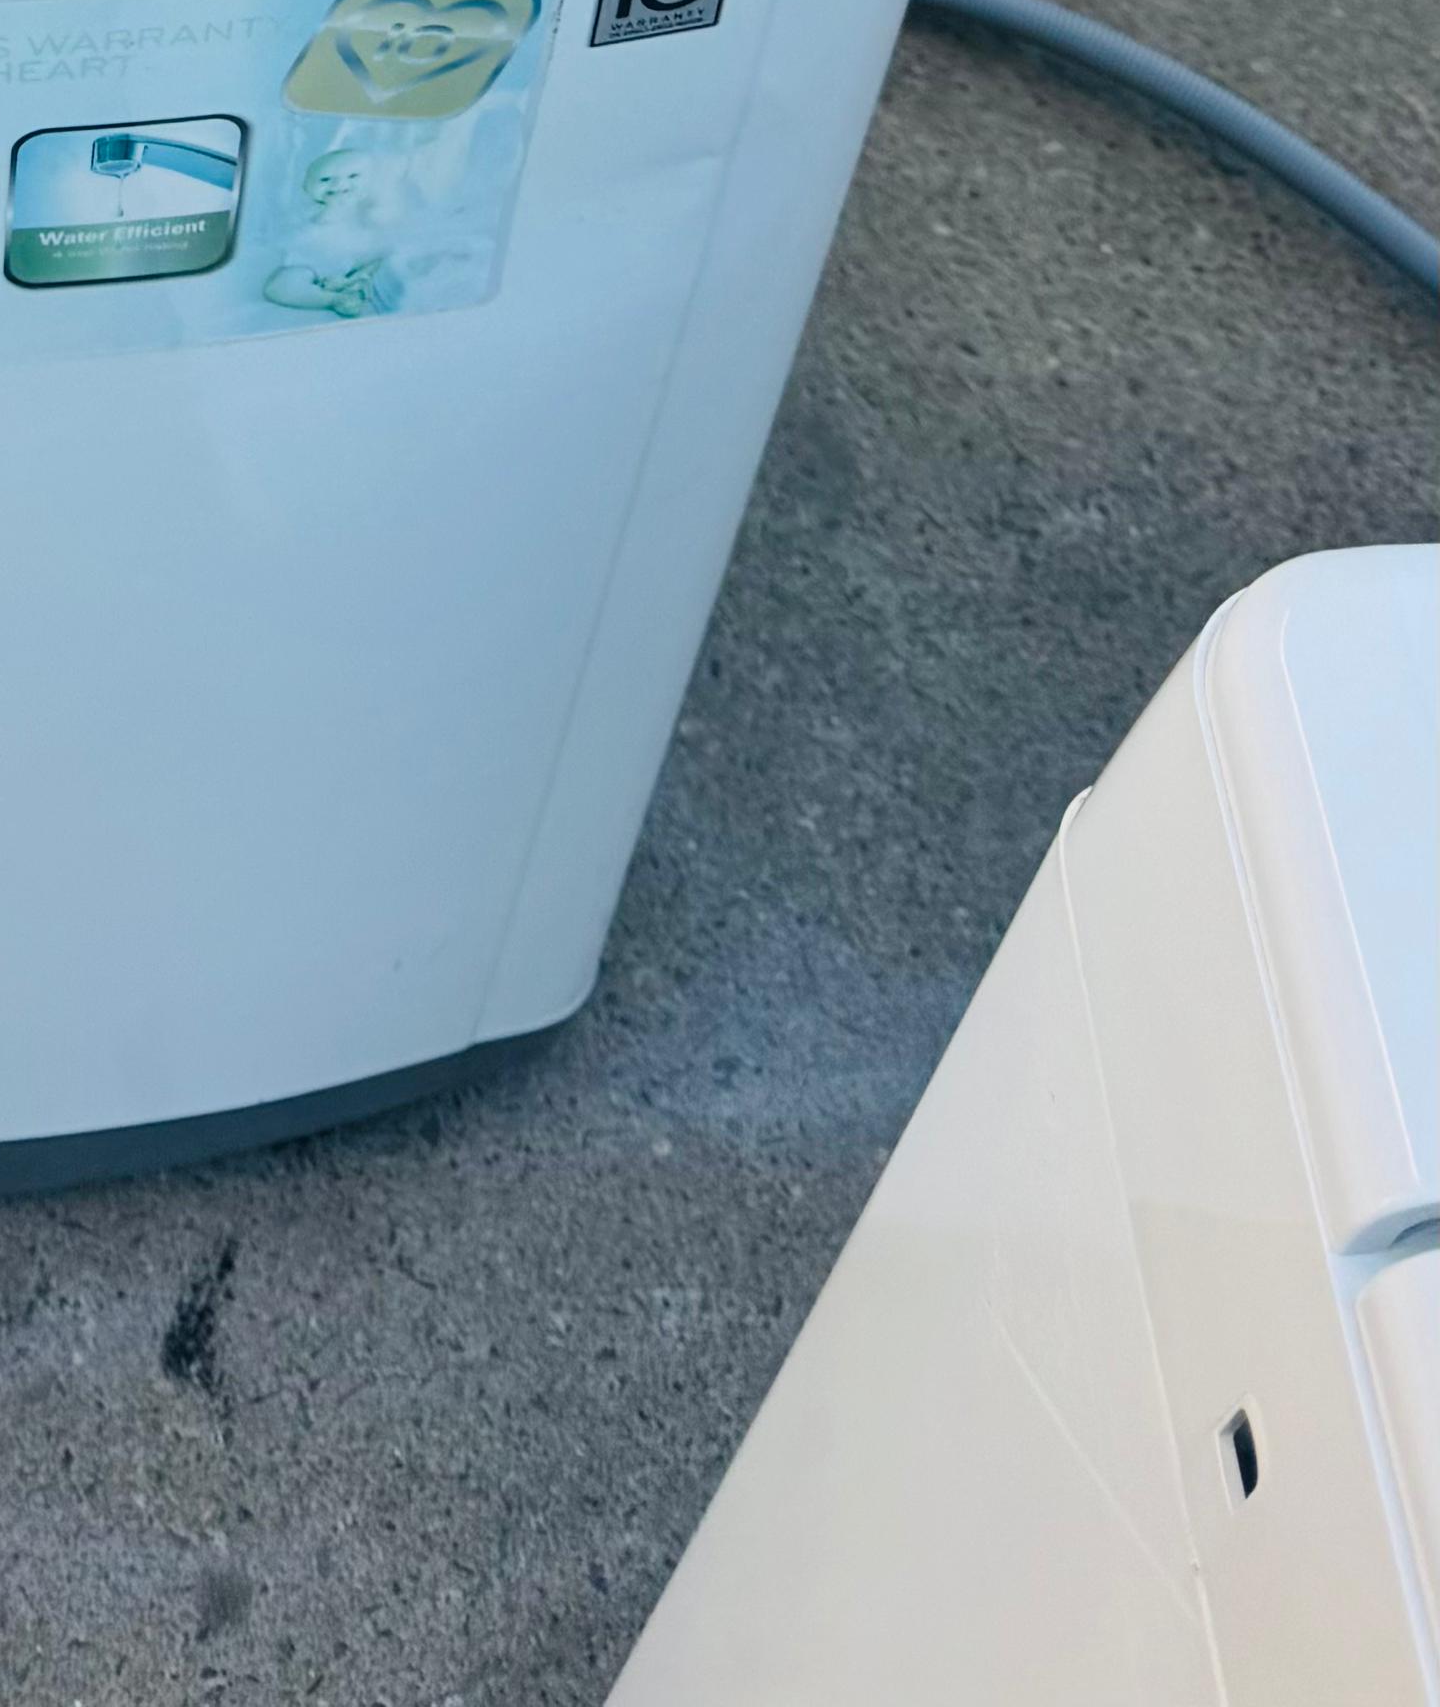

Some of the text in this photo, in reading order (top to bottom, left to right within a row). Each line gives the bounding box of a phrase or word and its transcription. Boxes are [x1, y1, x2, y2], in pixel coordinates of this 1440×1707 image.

[611, 9, 705, 30] WARRANTY
[40, 220, 206, 246] Water Efficient
